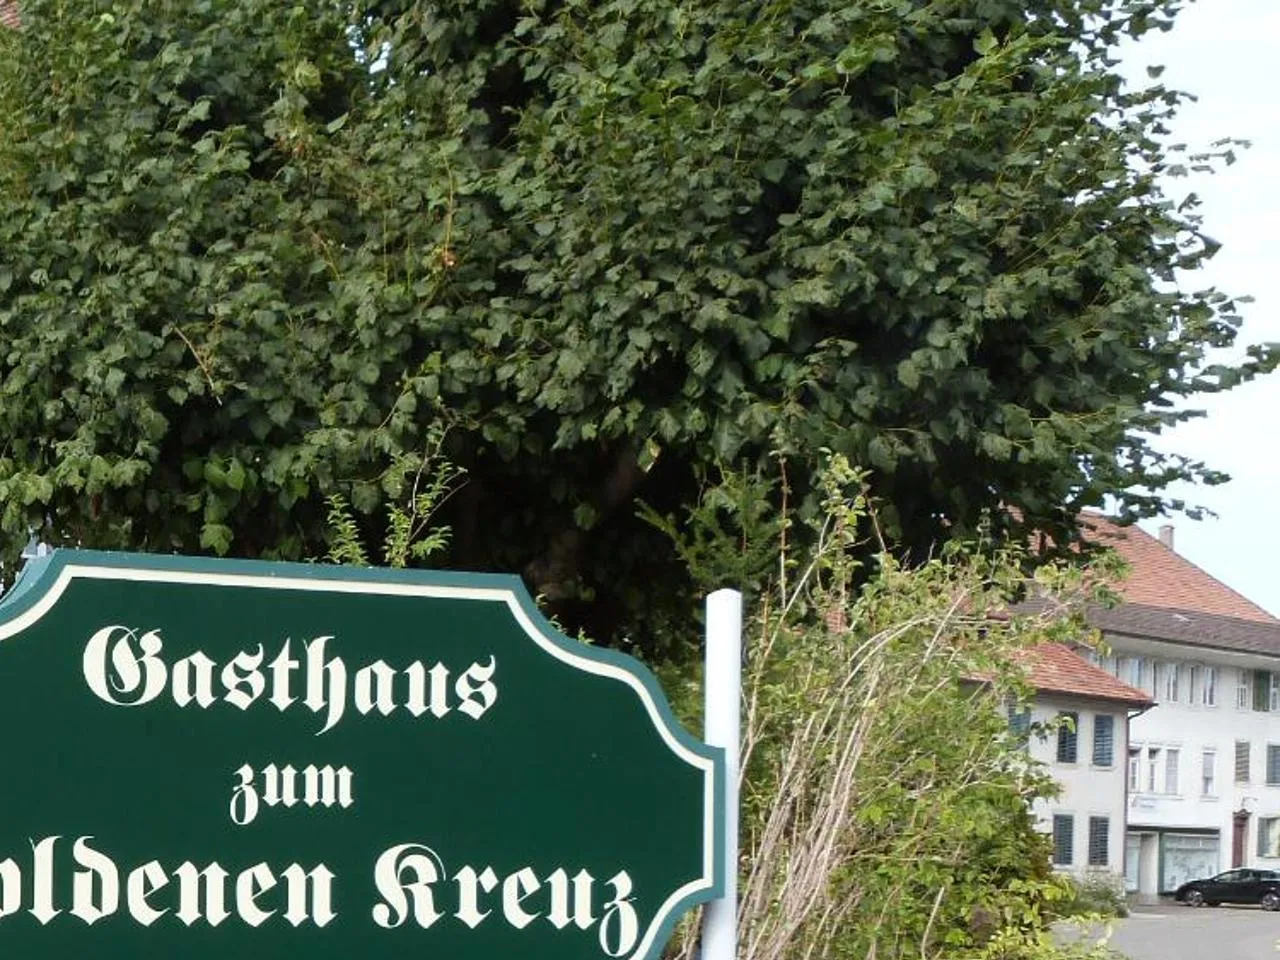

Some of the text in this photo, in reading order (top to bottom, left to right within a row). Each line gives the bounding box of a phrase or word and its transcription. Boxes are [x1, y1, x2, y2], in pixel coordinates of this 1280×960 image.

[83, 625, 498, 736] Gasthaus
[229, 762, 354, 826] zum
[372, 843, 639, 957] Kreuz
